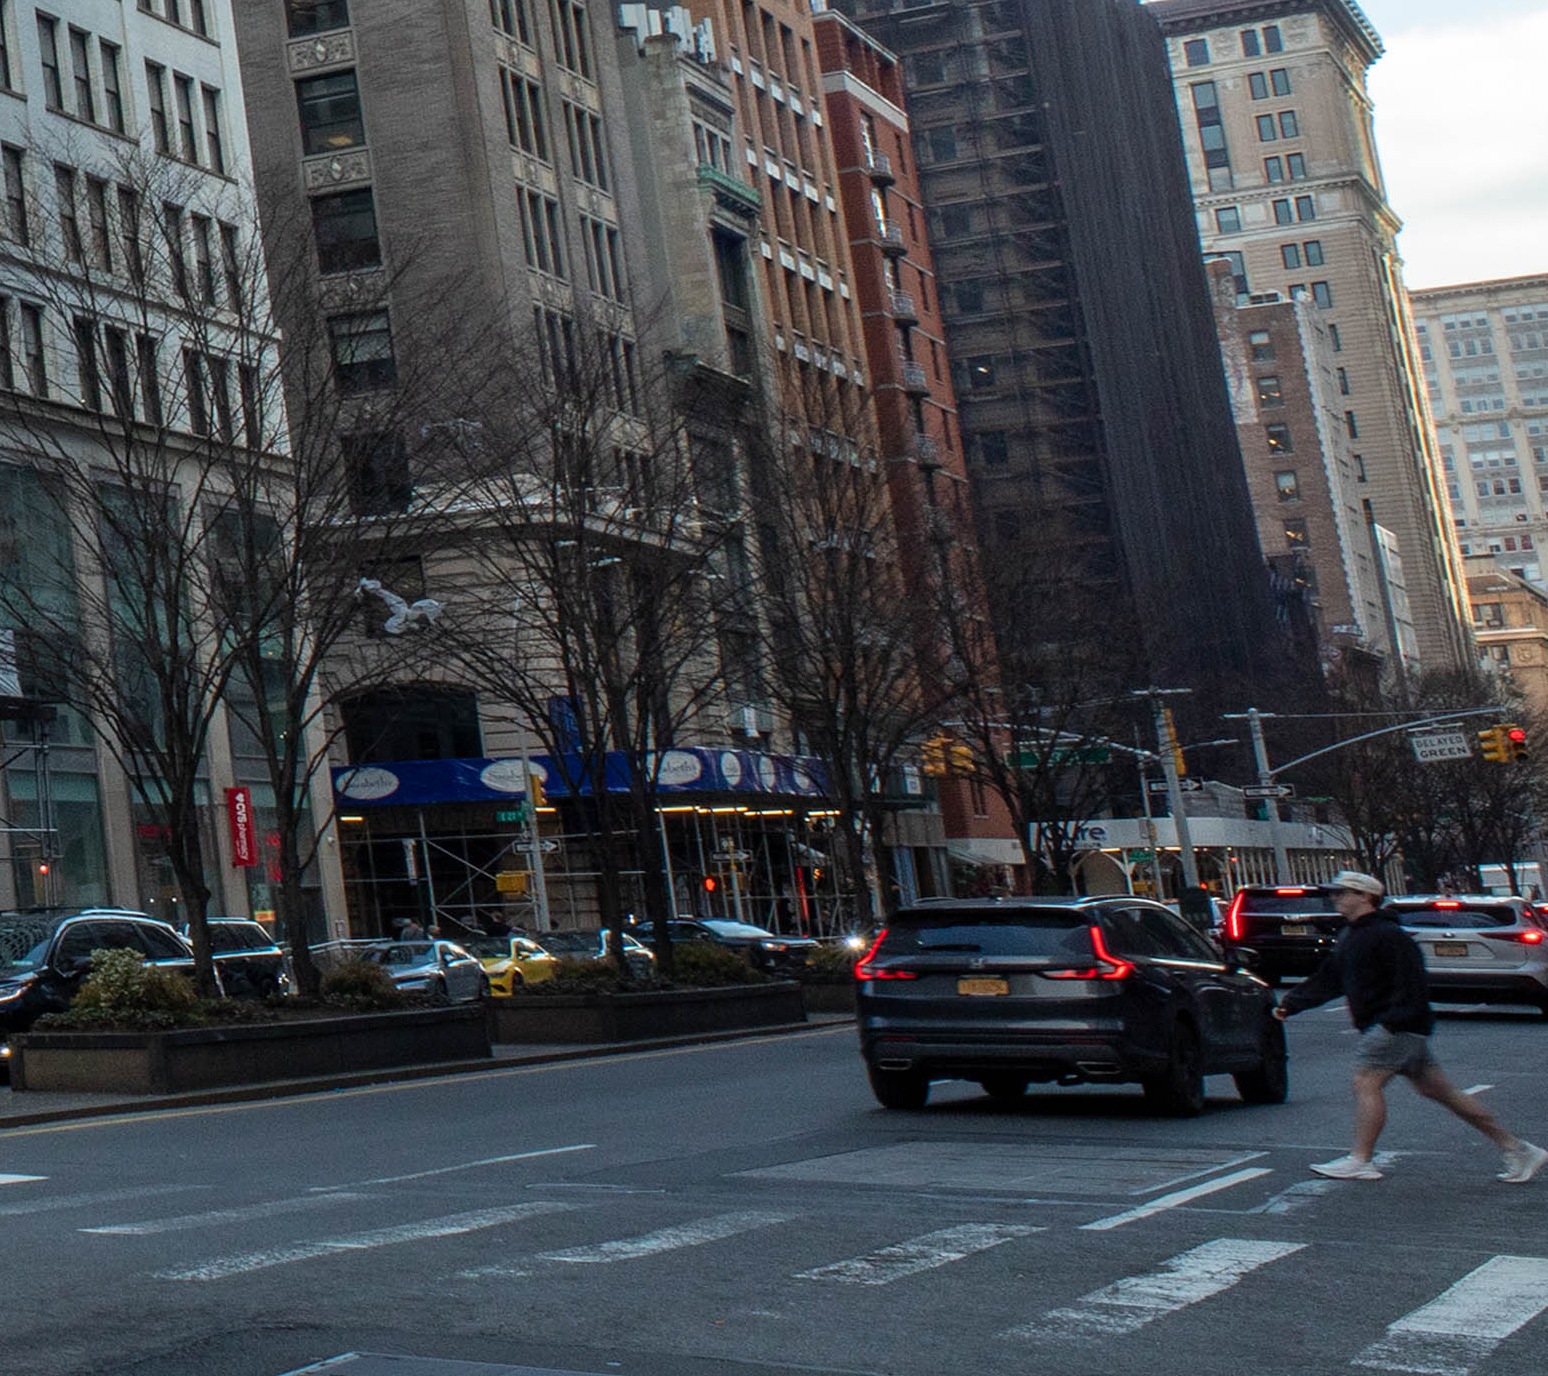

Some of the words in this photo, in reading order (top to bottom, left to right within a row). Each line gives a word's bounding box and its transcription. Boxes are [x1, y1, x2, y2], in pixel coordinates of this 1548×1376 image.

[1415, 735, 1464, 748] DELAYED
[1419, 746, 1468, 759] GREEN
[236, 803, 247, 823] CVS
[238, 824, 249, 860] pharmacy
